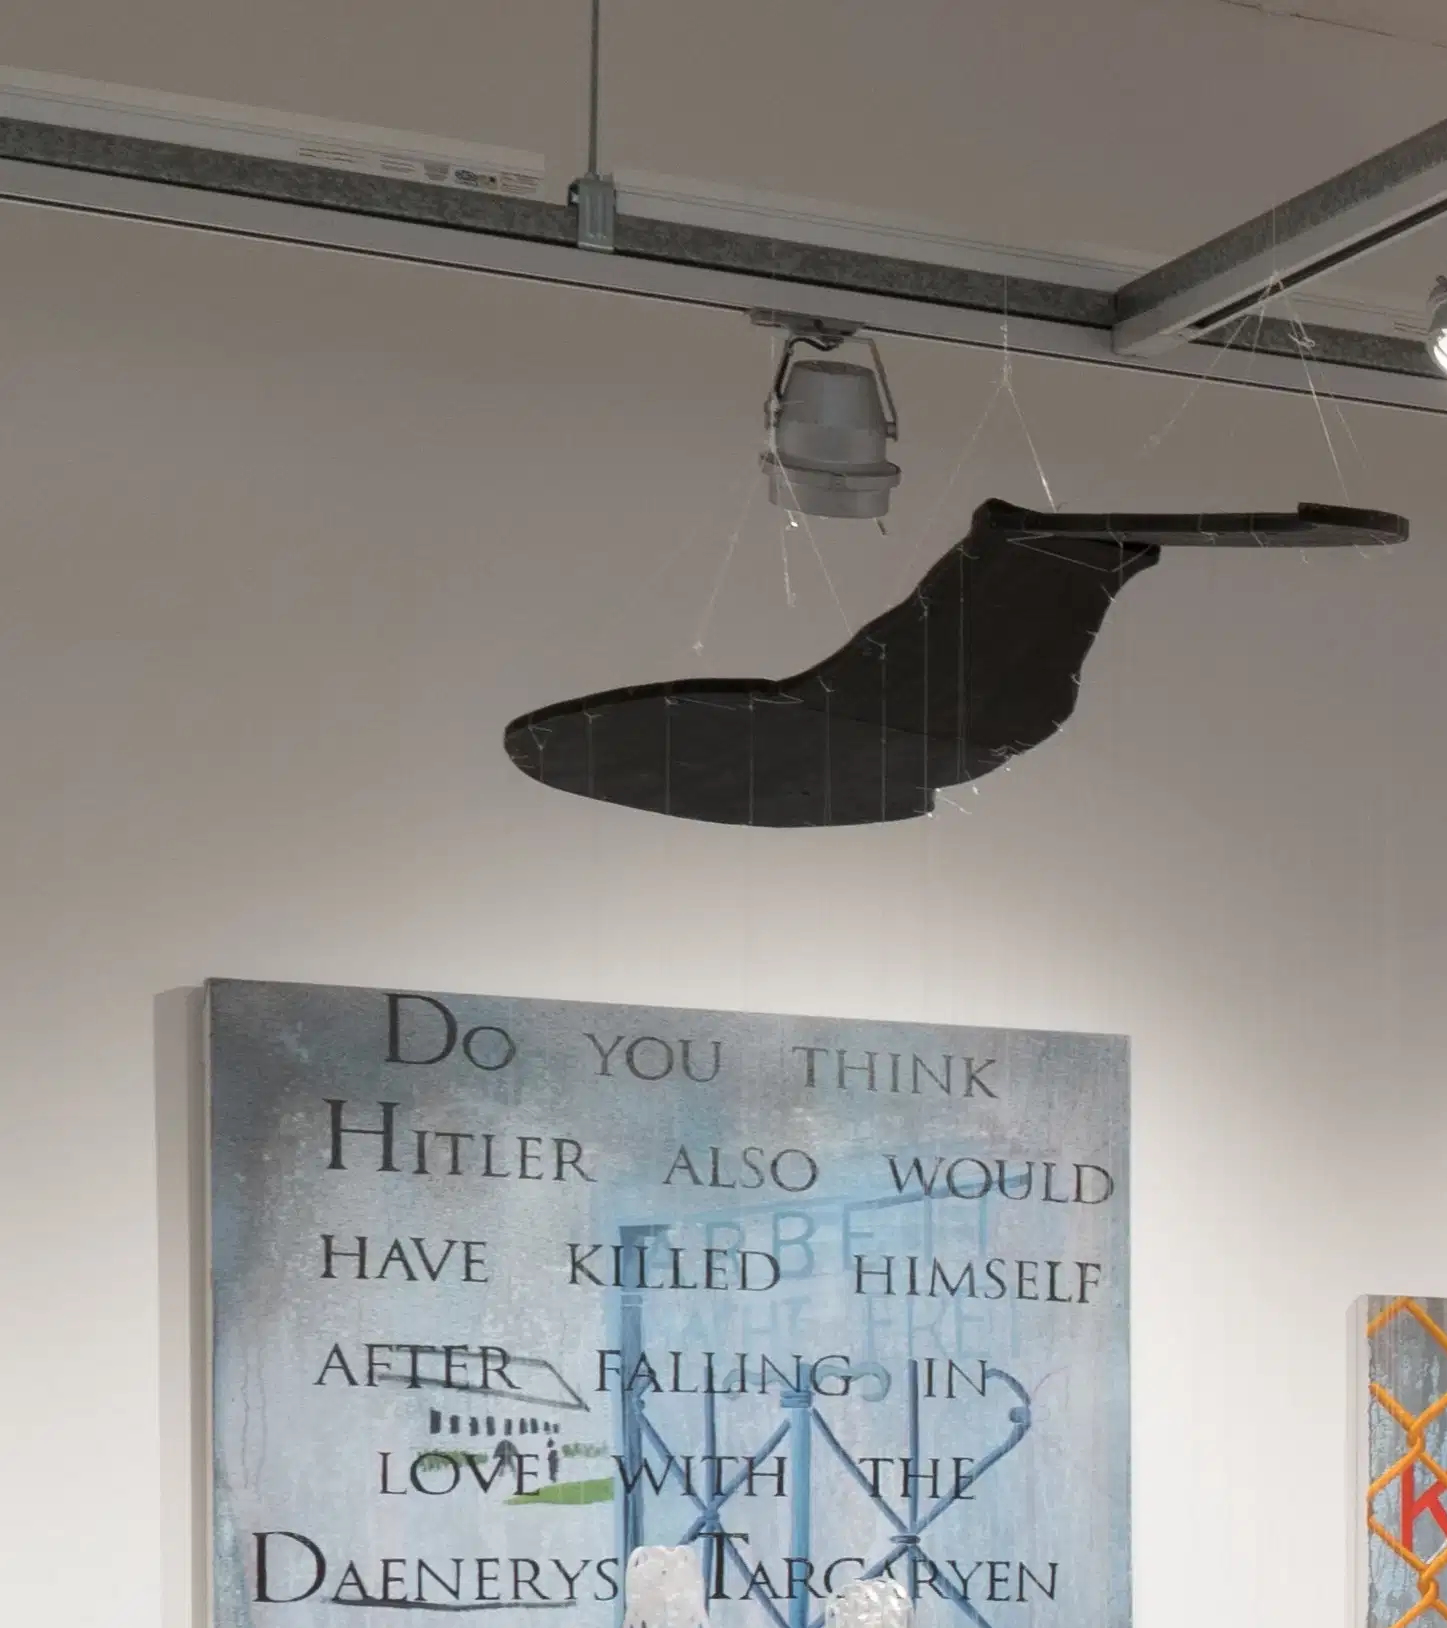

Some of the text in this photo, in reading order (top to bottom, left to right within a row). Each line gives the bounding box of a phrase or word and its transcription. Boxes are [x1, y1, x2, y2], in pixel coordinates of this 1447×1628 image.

[584, 1032, 723, 1084] YOU
[791, 1044, 1000, 1100] THINK
[662, 1143, 819, 1194] ALSO
[885, 1153, 1115, 1206] WOULD
[320, 1233, 1104, 1304] HAVE KILLED HIMSELF
[313, 1343, 990, 1399] AFTER FALLING IN
[379, 1451, 977, 1502] LOVE WITH THE
